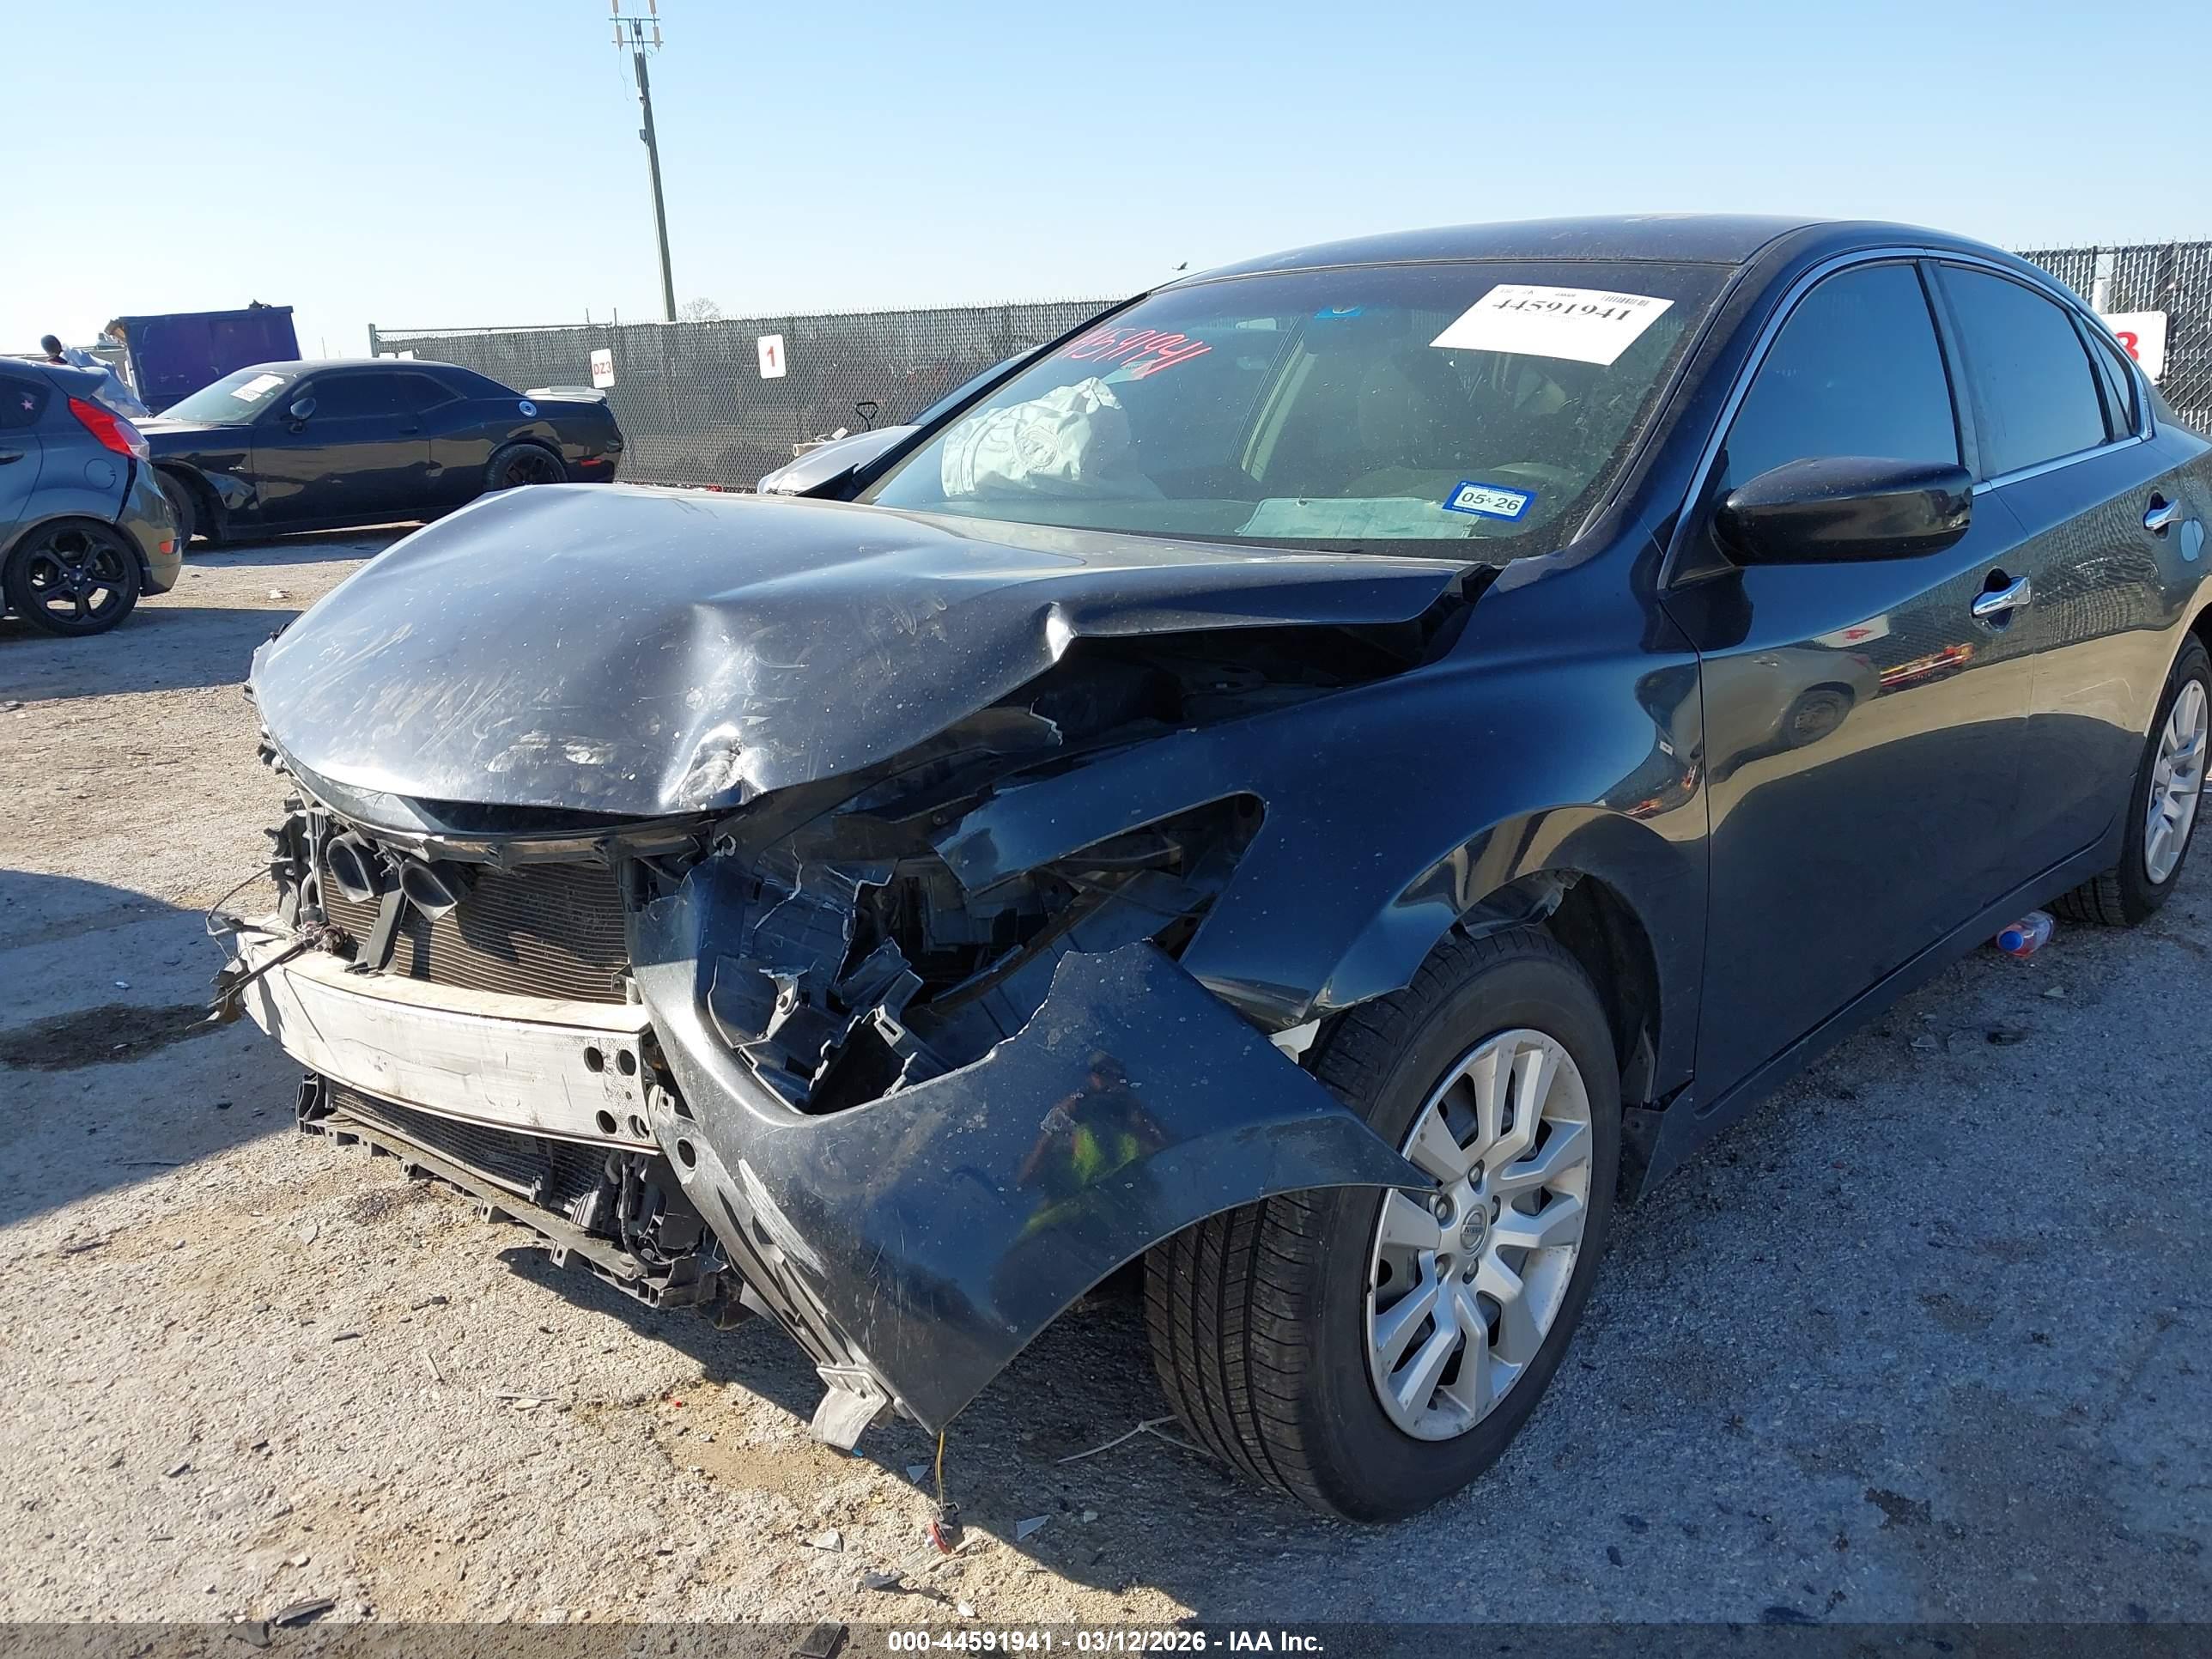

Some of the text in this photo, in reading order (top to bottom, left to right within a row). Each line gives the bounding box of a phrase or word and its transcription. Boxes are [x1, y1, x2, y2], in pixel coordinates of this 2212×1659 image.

[1492, 299, 1632, 320] 44591941
[767, 345, 775, 368] 1
[593, 361, 612, 375] DZ3
